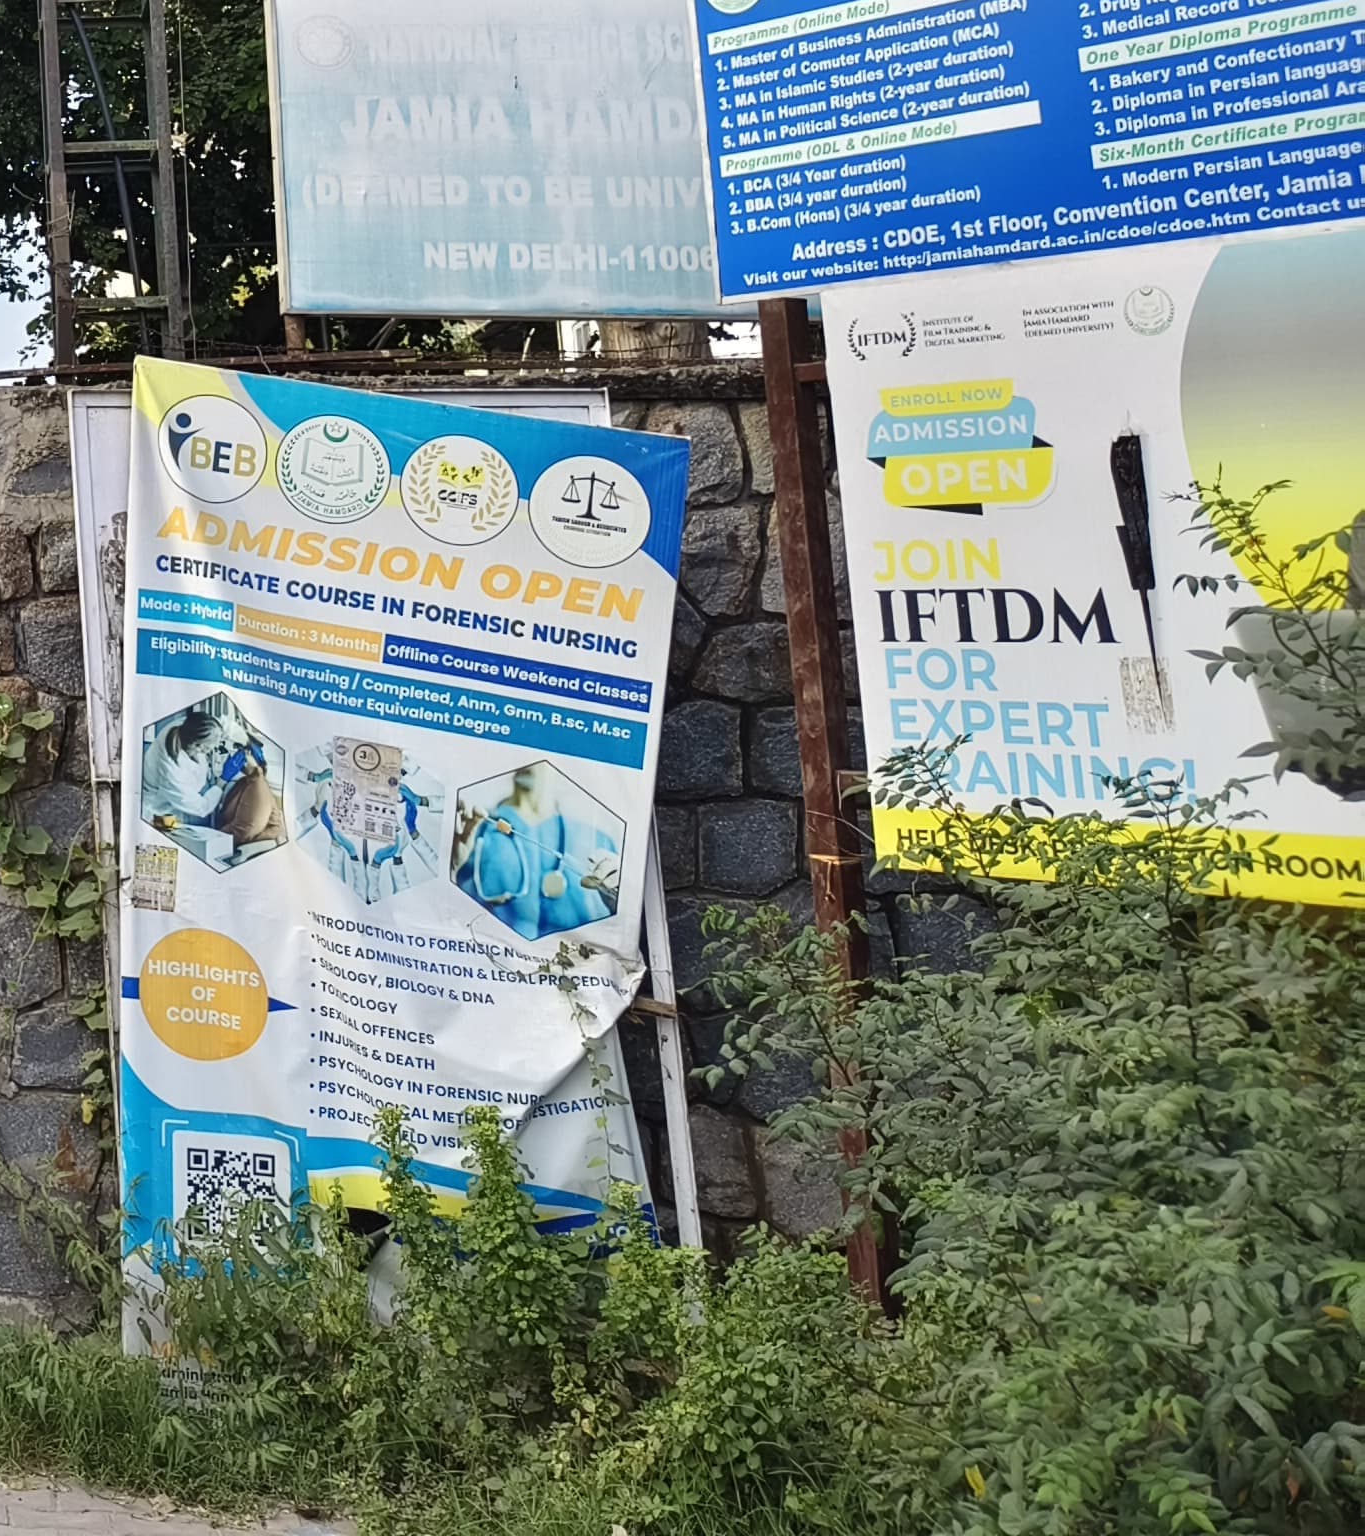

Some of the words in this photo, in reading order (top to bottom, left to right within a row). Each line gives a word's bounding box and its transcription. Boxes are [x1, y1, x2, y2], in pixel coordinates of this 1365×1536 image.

[713, 23, 789, 48] Programme
[793, 12, 842, 33] (Online
[715, 59, 727, 72] 1.
[730, 50, 777, 69] Master
[780, 43, 794, 58] of
[798, 32, 862, 55] Business
[865, 8, 975, 41] Administration
[1086, 50, 1119, 64] One
[1125, 41, 1163, 57] Year
[1169, 27, 1240, 50] Diploma
[1247, 5, 1356, 34] Programme
[341, 96, 517, 145] JAMIA
[530, 95, 704, 144] HAMD
[1101, 175, 1117, 189] 1.
[1122, 167, 1188, 187] Modern
[1193, 155, 1262, 177] Persian
[1267, 141, 1362, 165] Language
[475, 176, 531, 208] TO
[544, 176, 593, 207] BE
[791, 238, 866, 260] Address
[883, 224, 945, 248] CDOE,
[951, 219, 983, 239] 1st
[988, 214, 1047, 234] Floor,
[1053, 195, 1177, 225] Convention
[1184, 183, 1269, 207] Center,
[1276, 168, 1352, 195] Jamia
[424, 241, 498, 270] NEW
[857, 331, 907, 348] IFTDM
[890, 391, 955, 409] ENROLL
[961, 386, 1003, 403] NOW
[874, 414, 1028, 444] ADMISSION
[189, 441, 257, 478] BEB
[901, 458, 1028, 497] OPEN
[157, 506, 465, 591] ADMISSION
[480, 563, 645, 623] OPEN
[873, 537, 1002, 583] JOIN
[140, 596, 181, 613] Mode
[191, 601, 233, 622] Hybrid
[156, 554, 280, 594] CERTIFICATE
[286, 580, 376, 612] COURSE
[381, 596, 405, 617] IN
[411, 601, 526, 638] FORENSIC
[532, 623, 638, 658] NURSING
[874, 587, 1121, 645] IFTDM
[238, 614, 299, 640] Duration
[309, 629, 318, 642] 3
[321, 631, 380, 655] Months
[387, 644, 439, 665] Offline
[442, 654, 500, 676] Course
[503, 666, 580, 691] Weekend
[583, 680, 648, 705] Classes
[885, 648, 998, 692] FOR
[233, 667, 287, 695] Nursing
[290, 684, 318, 702] Any
[321, 689, 364, 708] Other
[366, 698, 451, 724] Equivalent
[453, 714, 511, 736] Degree
[283, 662, 349, 689] Pursuing
[362, 677, 454, 706] Completed,
[457, 694, 500, 716] Anm,
[503, 704, 548, 726] Gnm,
[593, 721, 632, 740] M.sc
[890, 698, 1110, 748] EXPERT
[148, 959, 261, 988] HIGHLIGHTS
[191, 986, 216, 1002] OF
[385, 976, 444, 998] BIOLOGY
[448, 989, 459, 1001] &
[462, 991, 495, 1005] DNA
[166, 1007, 242, 1031] COURSE
[320, 1005, 359, 1032] SEXUAL
[361, 1022, 435, 1045] OFFENCES
[319, 1030, 368, 1058] INJURIES
[371, 1049, 382, 1062] &
[385, 1052, 436, 1071] DEATH
